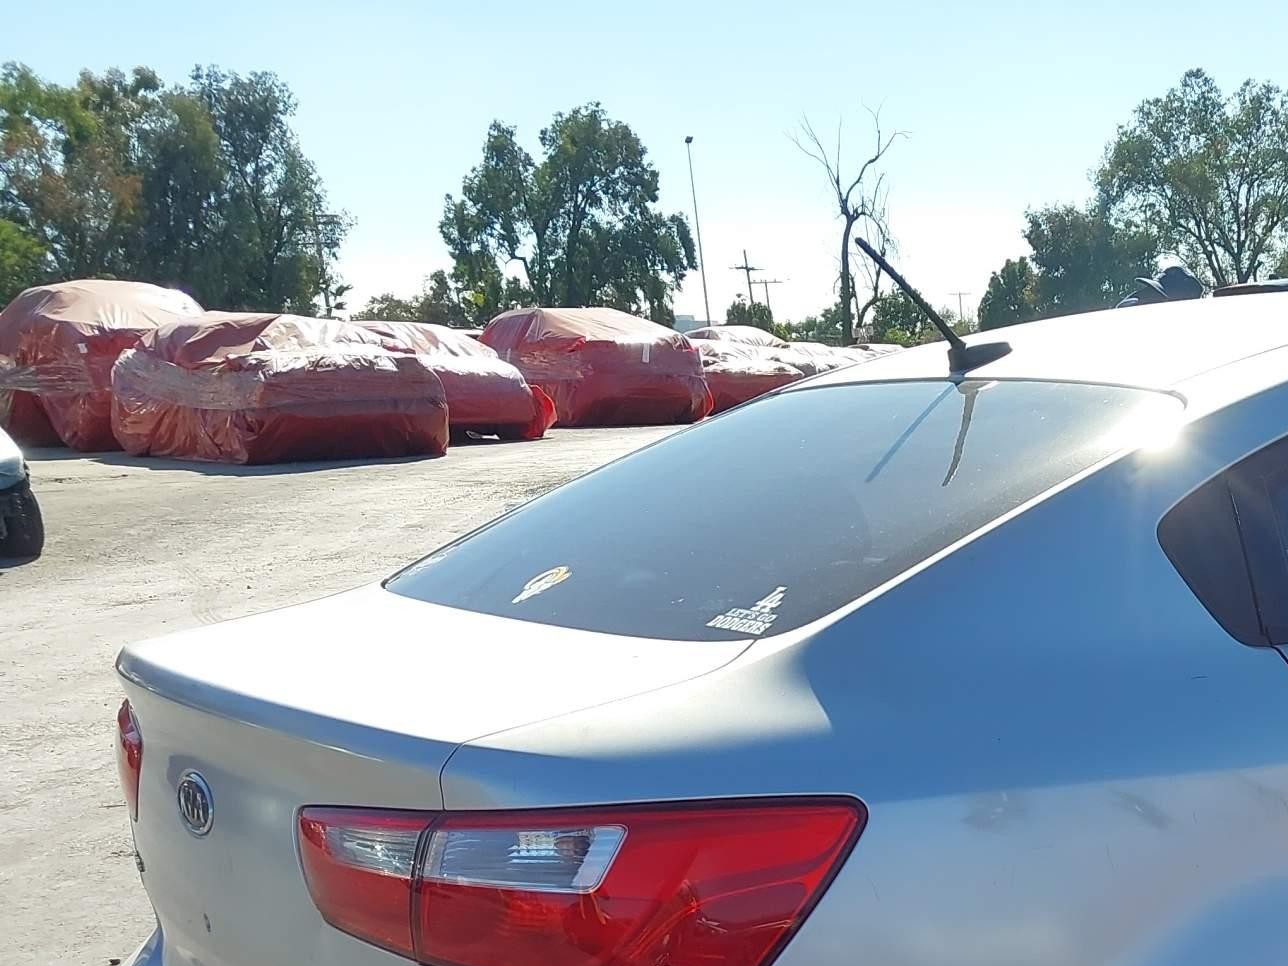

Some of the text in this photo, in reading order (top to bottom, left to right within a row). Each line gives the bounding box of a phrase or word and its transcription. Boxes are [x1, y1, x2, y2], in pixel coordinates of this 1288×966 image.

[750, 586, 788, 613] LA
[705, 615, 773, 635] DODGERS
[725, 608, 779, 623] LET'S GO
